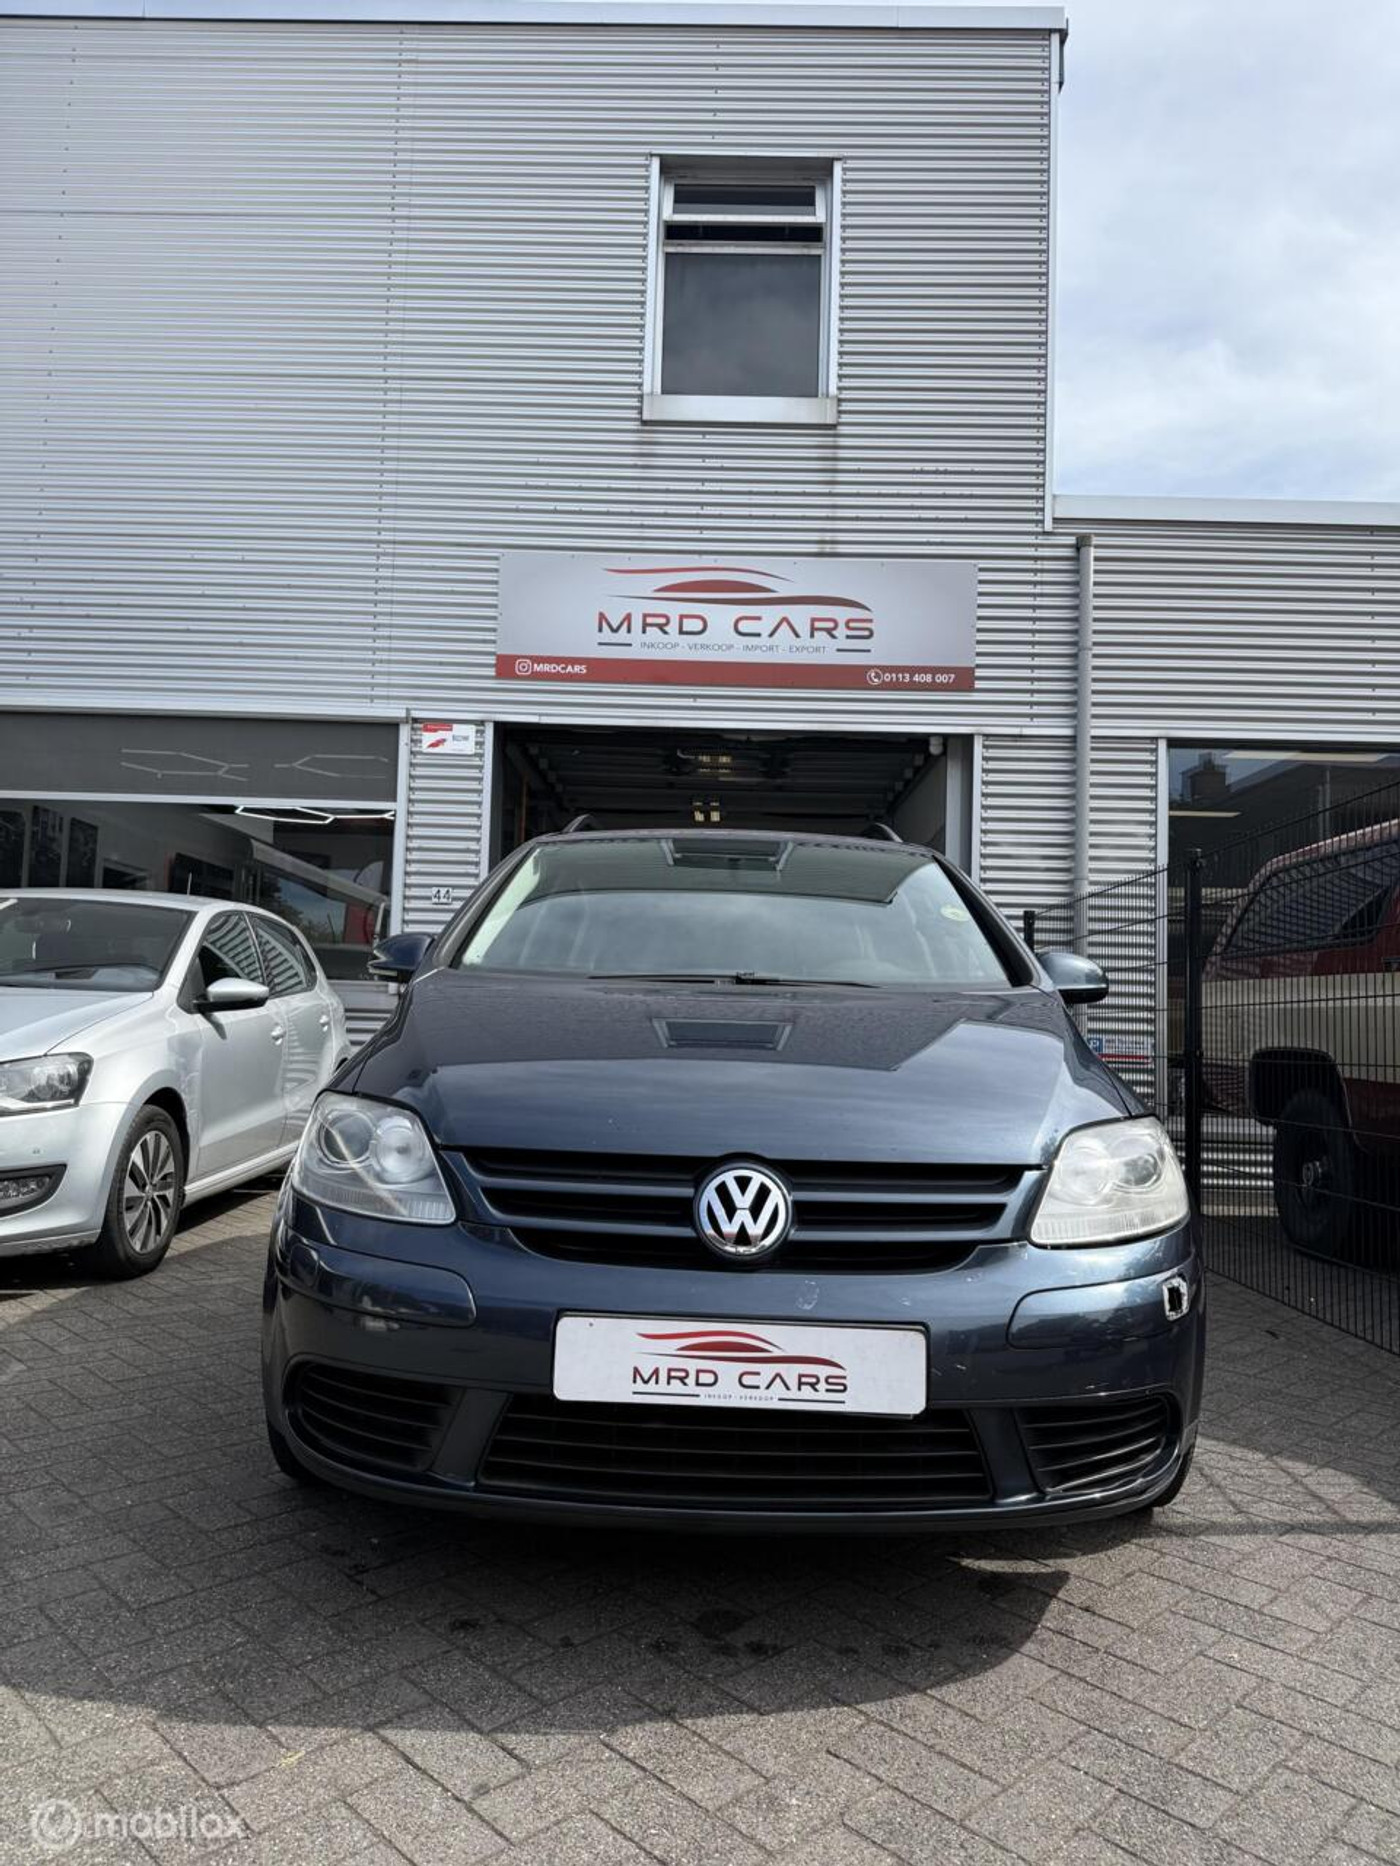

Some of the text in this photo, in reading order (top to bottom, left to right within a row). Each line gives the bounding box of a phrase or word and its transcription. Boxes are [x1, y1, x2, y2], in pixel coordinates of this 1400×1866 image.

[597, 611, 874, 640] MRD CARS
[640, 641, 680, 650] INKOOP
[687, 642, 735, 652] VERKOOP
[742, 644, 779, 653] IMPORT
[788, 645, 826, 654] EXPORT
[533, 663, 588, 674] MRDCARS
[883, 673, 955, 683] 0113 408 007
[433, 888, 450, 900] 44
[632, 1366, 848, 1393] MRD CARS
